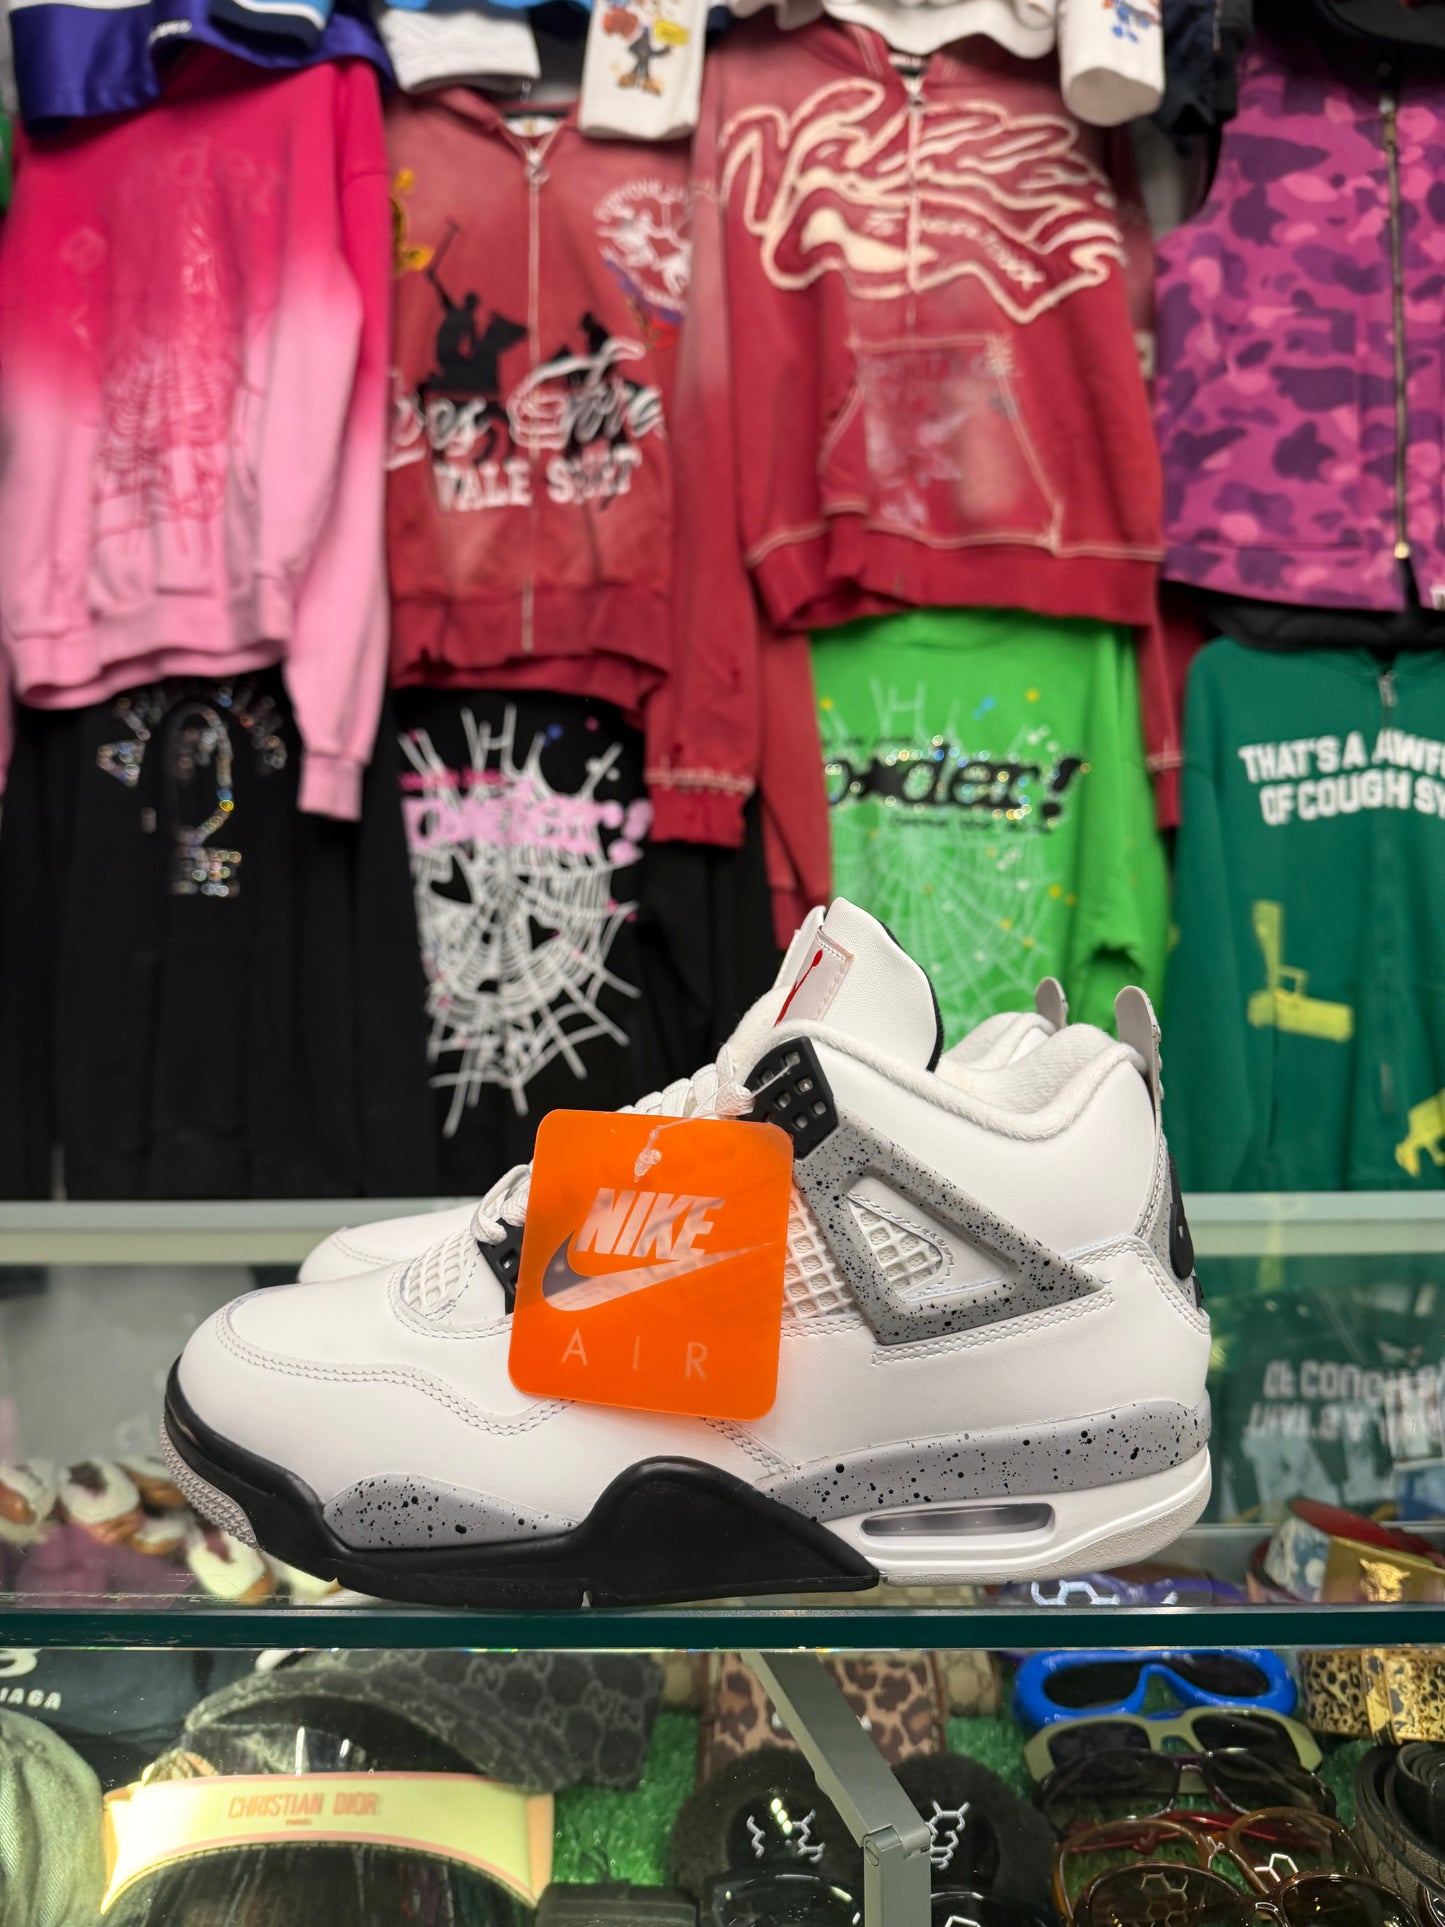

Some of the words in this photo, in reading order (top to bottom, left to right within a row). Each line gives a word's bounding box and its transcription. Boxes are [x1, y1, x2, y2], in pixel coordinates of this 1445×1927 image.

[433, 458, 532, 512] VALE
[1237, 734, 1341, 784] THAT'S
[1342, 730, 1367, 769] A
[1371, 727, 1445, 780] AWF
[1259, 783, 1295, 826] OF
[1297, 768, 1413, 821] COUGH
[573, 1188, 725, 1261] NIKE
[561, 1328, 708, 1380] AIR
[228, 1792, 324, 1819] CHRISTIAN
[333, 1791, 378, 1816] DIOR
